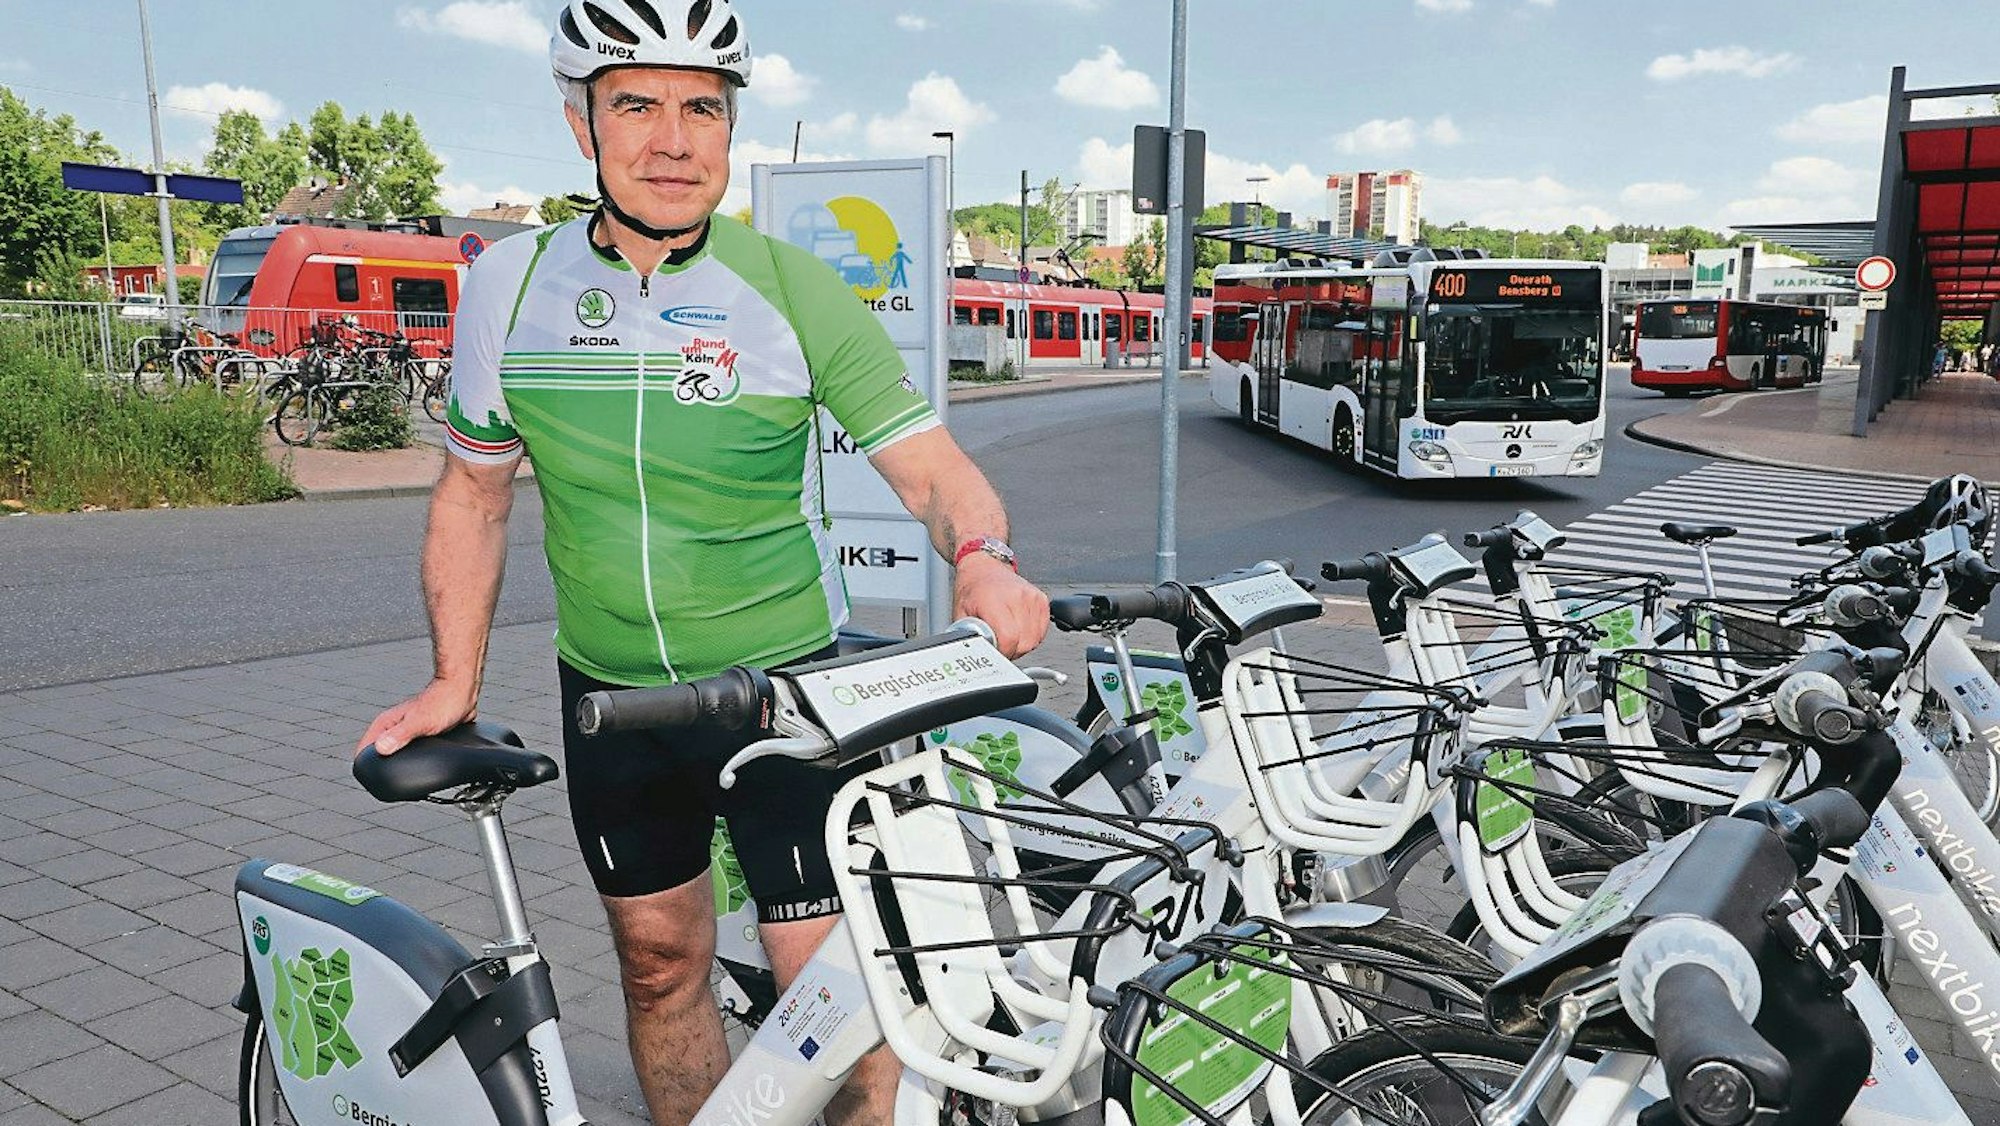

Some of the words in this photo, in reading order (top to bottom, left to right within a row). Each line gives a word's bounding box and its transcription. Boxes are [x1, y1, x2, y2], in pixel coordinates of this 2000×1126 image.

[597, 42, 636, 61] uvex
[1435, 273, 1467, 297] 400
[1510, 275, 1552, 285] Overath
[1499, 285, 1548, 297] Bensberg
[891, 296, 914, 312] GL
[672, 310, 728, 322] SCHWALBE
[692, 338, 726, 349] Rund
[686, 352, 714, 365] Köln
[839, 545, 886, 568] IKE
[853, 665, 945, 701] Bergisches
[943, 653, 994, 678] e-Bike
